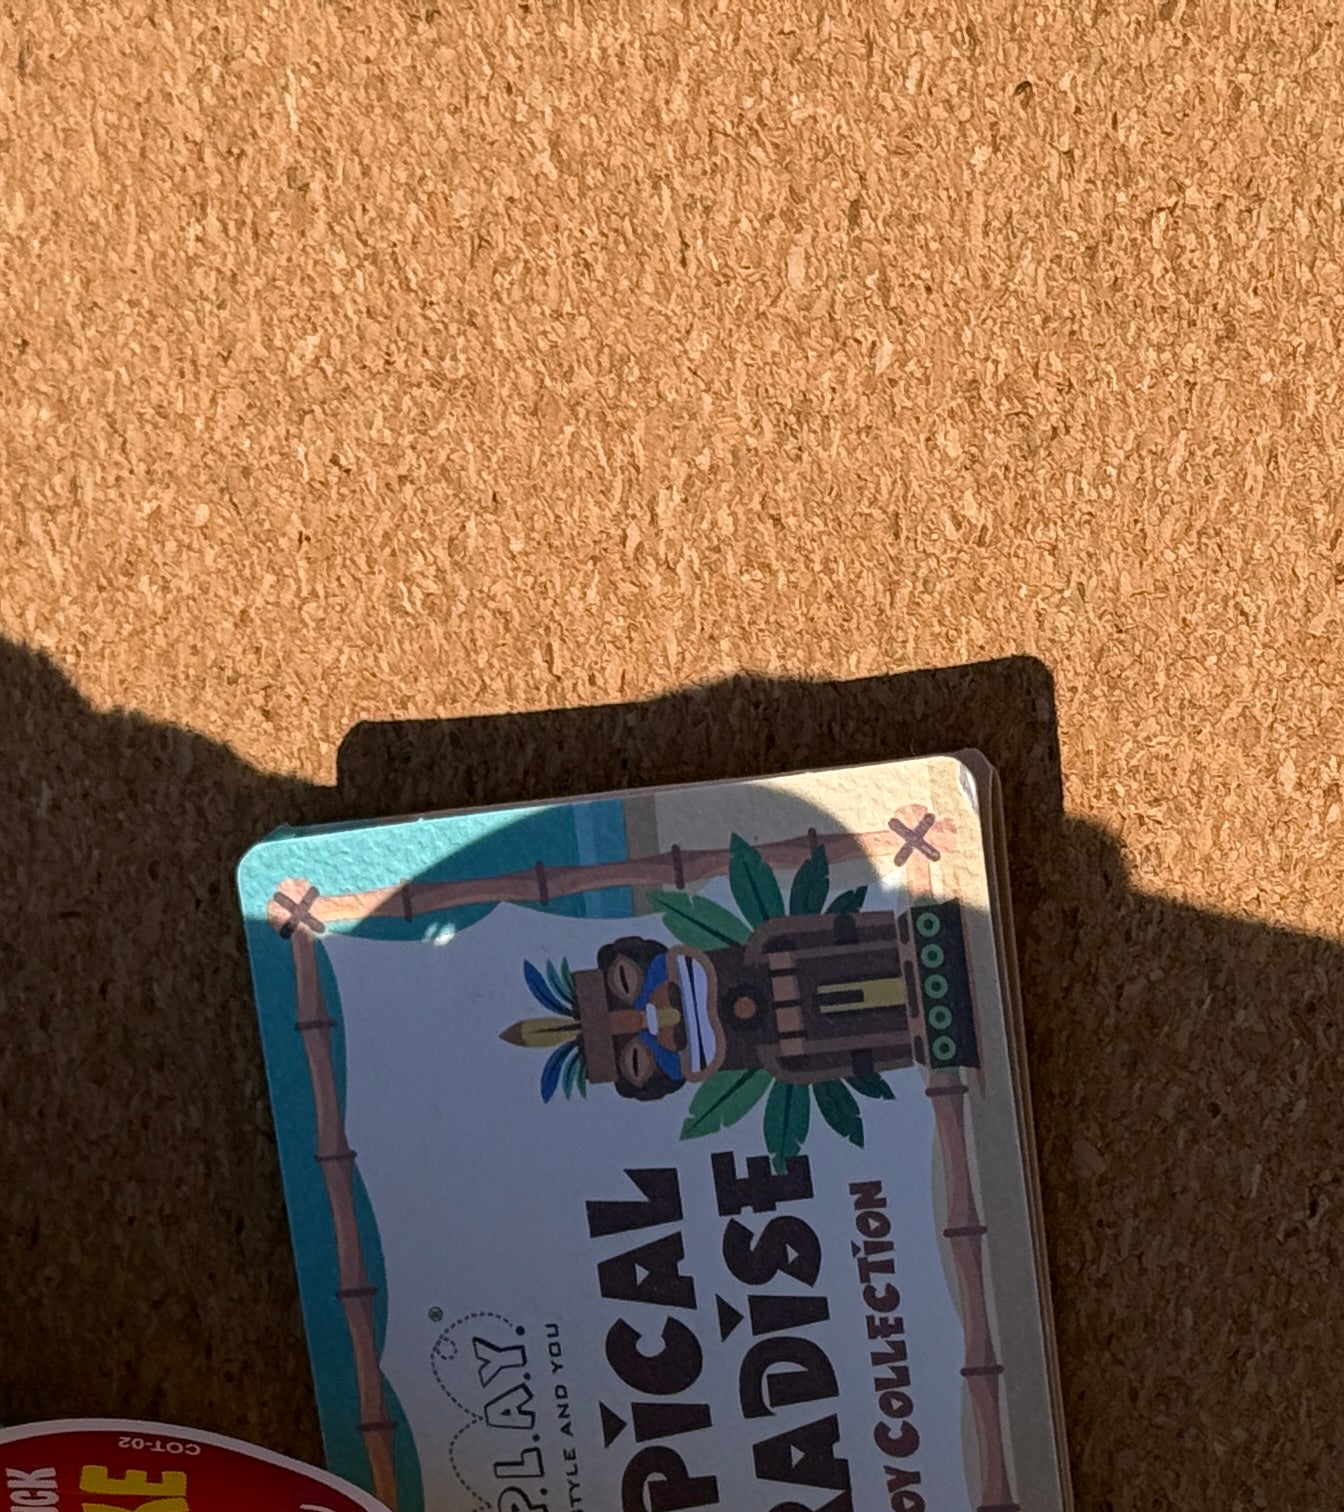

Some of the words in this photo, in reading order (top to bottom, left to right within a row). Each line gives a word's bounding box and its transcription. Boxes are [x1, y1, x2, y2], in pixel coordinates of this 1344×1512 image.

[848, 1179, 920, 1459] COLLECTION
[544, 1322, 564, 1374] YOU
[554, 1384, 573, 1435] AND
[118, 1435, 202, 1457] COT-02
